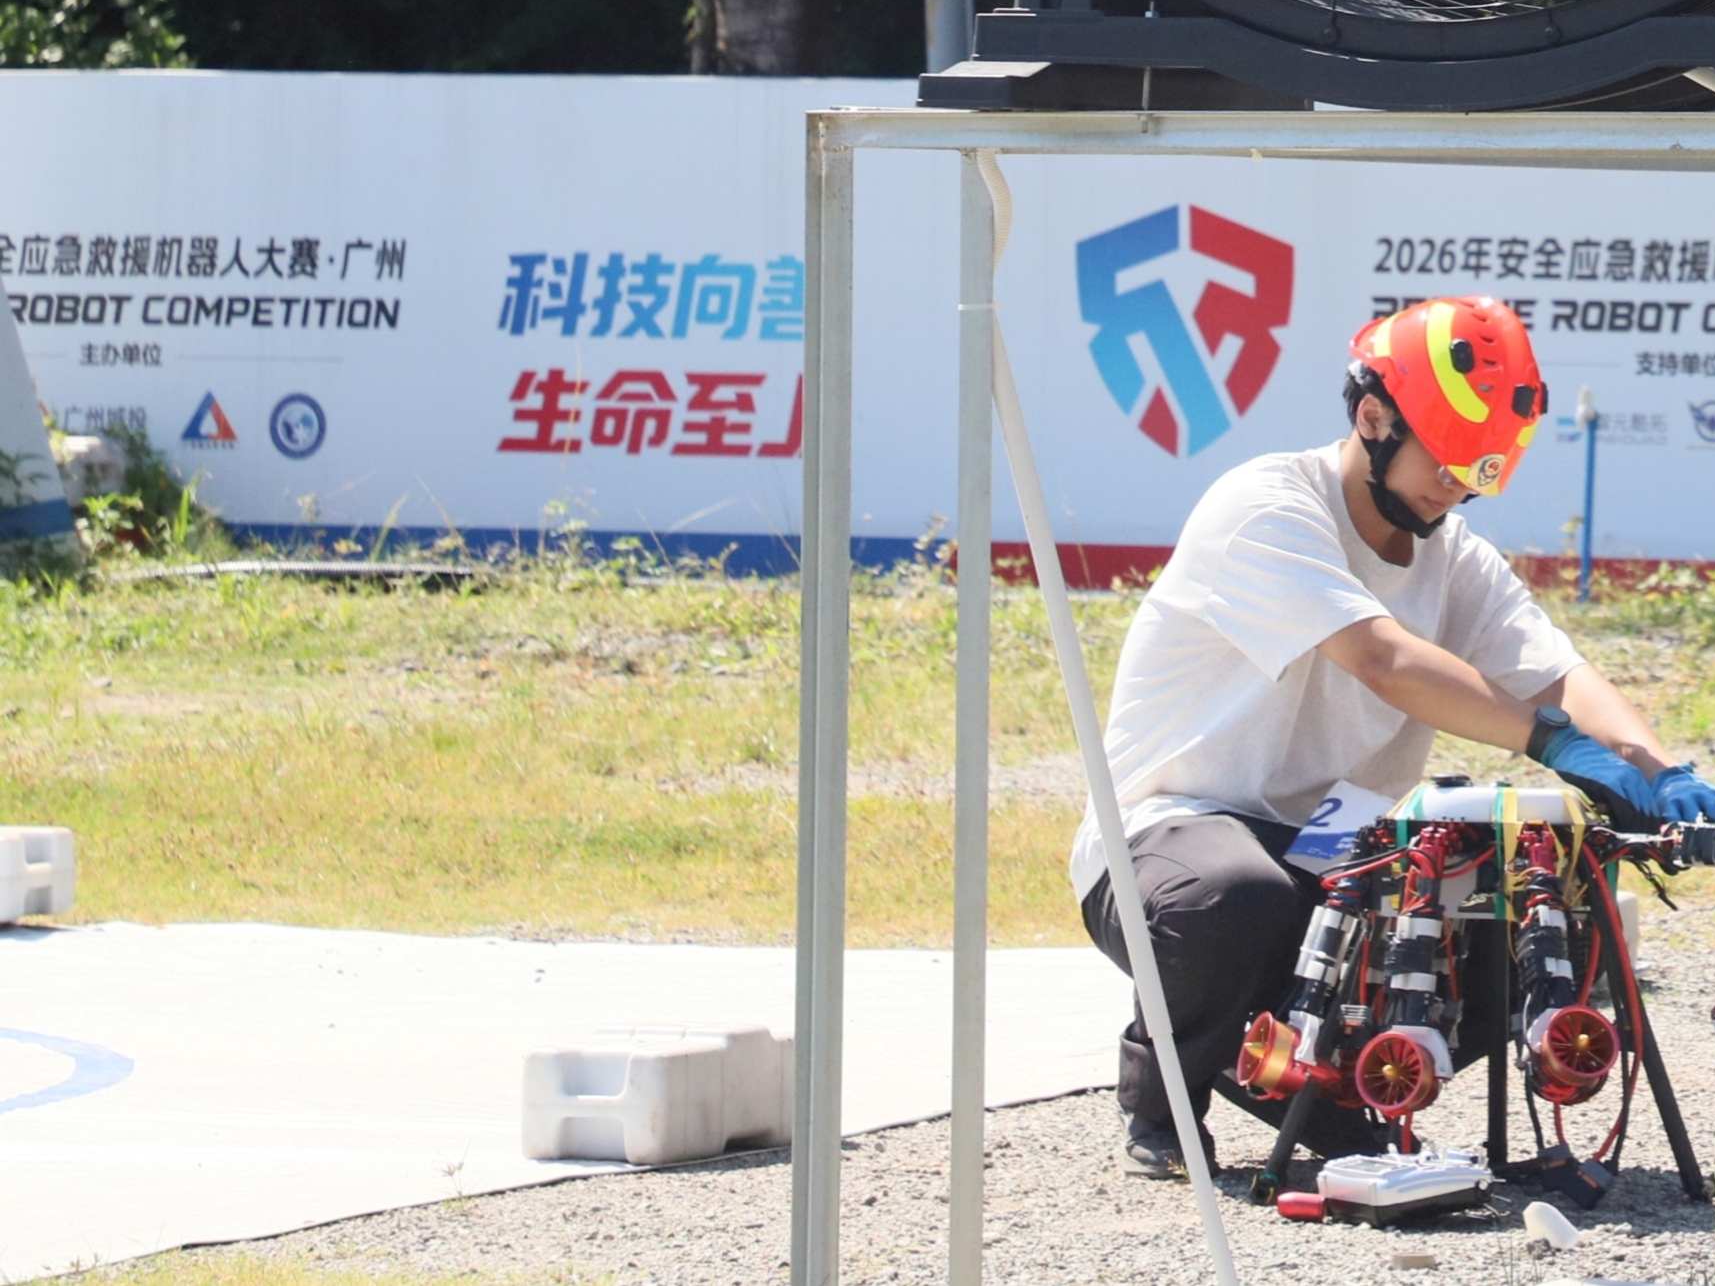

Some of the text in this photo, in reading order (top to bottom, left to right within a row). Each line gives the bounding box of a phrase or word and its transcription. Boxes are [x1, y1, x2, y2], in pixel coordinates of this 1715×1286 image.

[7, 294, 401, 329] ROBOT COMPETITION
[1552, 299, 1692, 334] ROBOT
[79, 342, 162, 367] 主办单位
